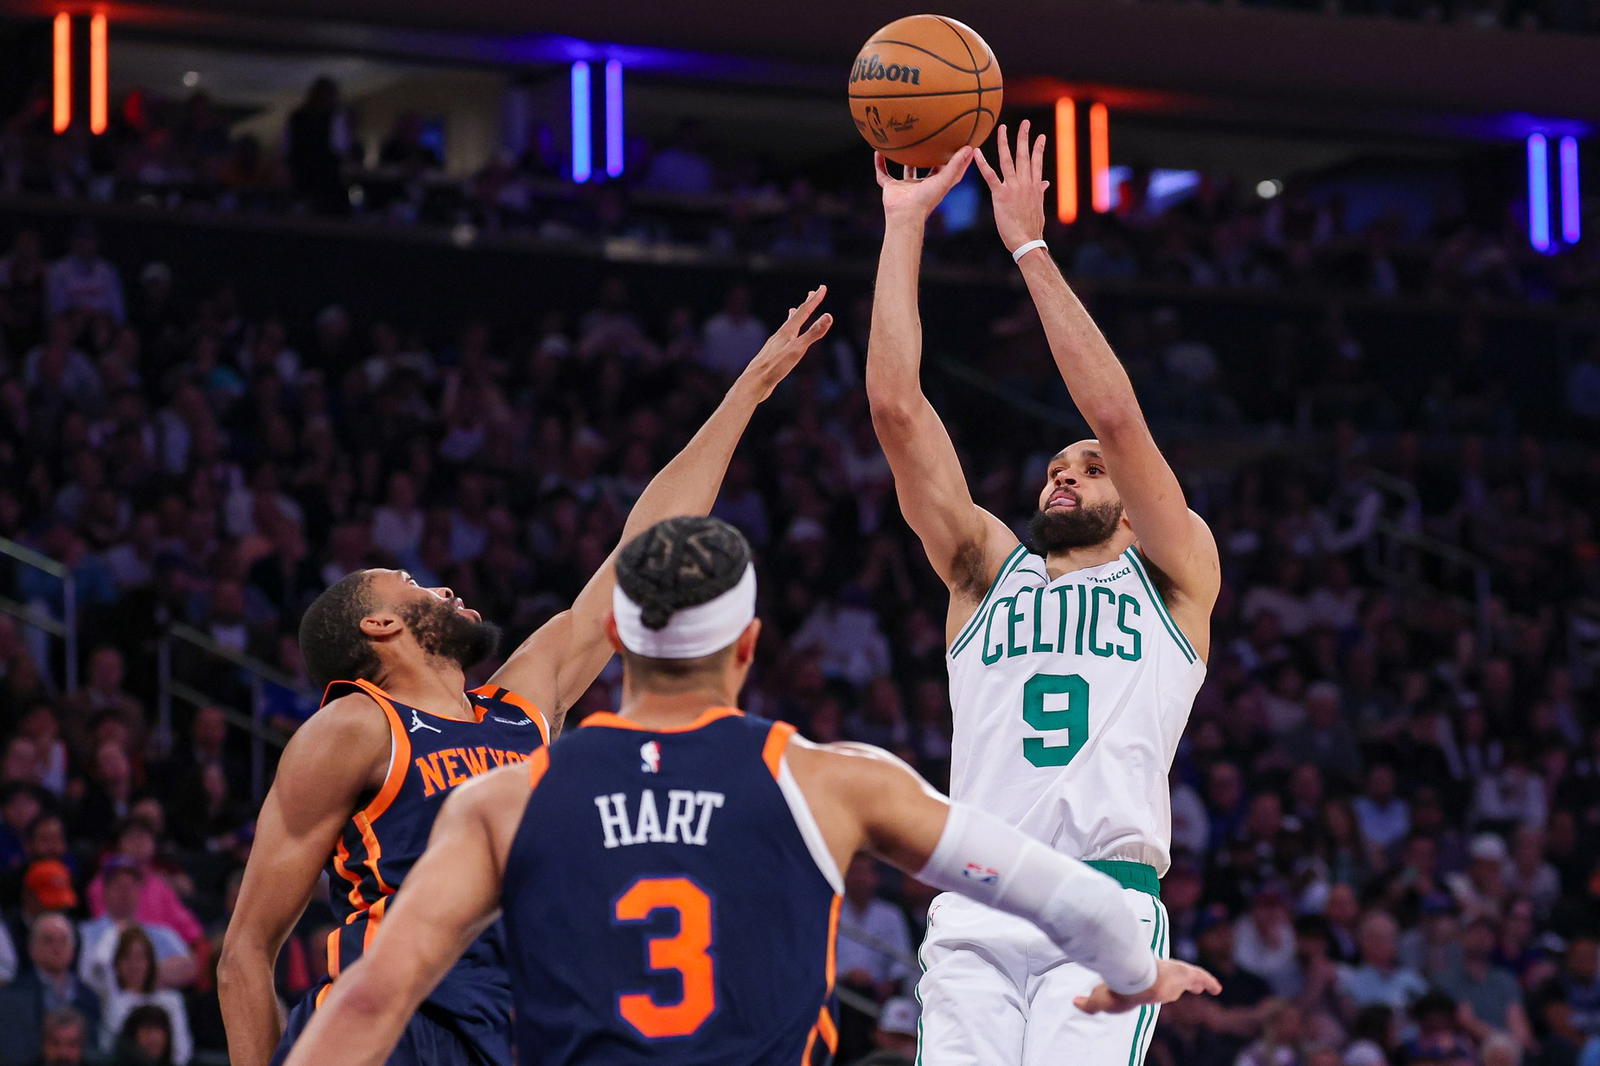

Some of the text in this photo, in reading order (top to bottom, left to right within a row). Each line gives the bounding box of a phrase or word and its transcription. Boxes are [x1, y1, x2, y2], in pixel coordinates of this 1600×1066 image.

[981, 584, 1142, 666] CELTICS
[1022, 673, 1090, 768] 9
[415, 746, 488, 797] NEW
[594, 789, 725, 849] HART
[614, 876, 716, 1039] 3
